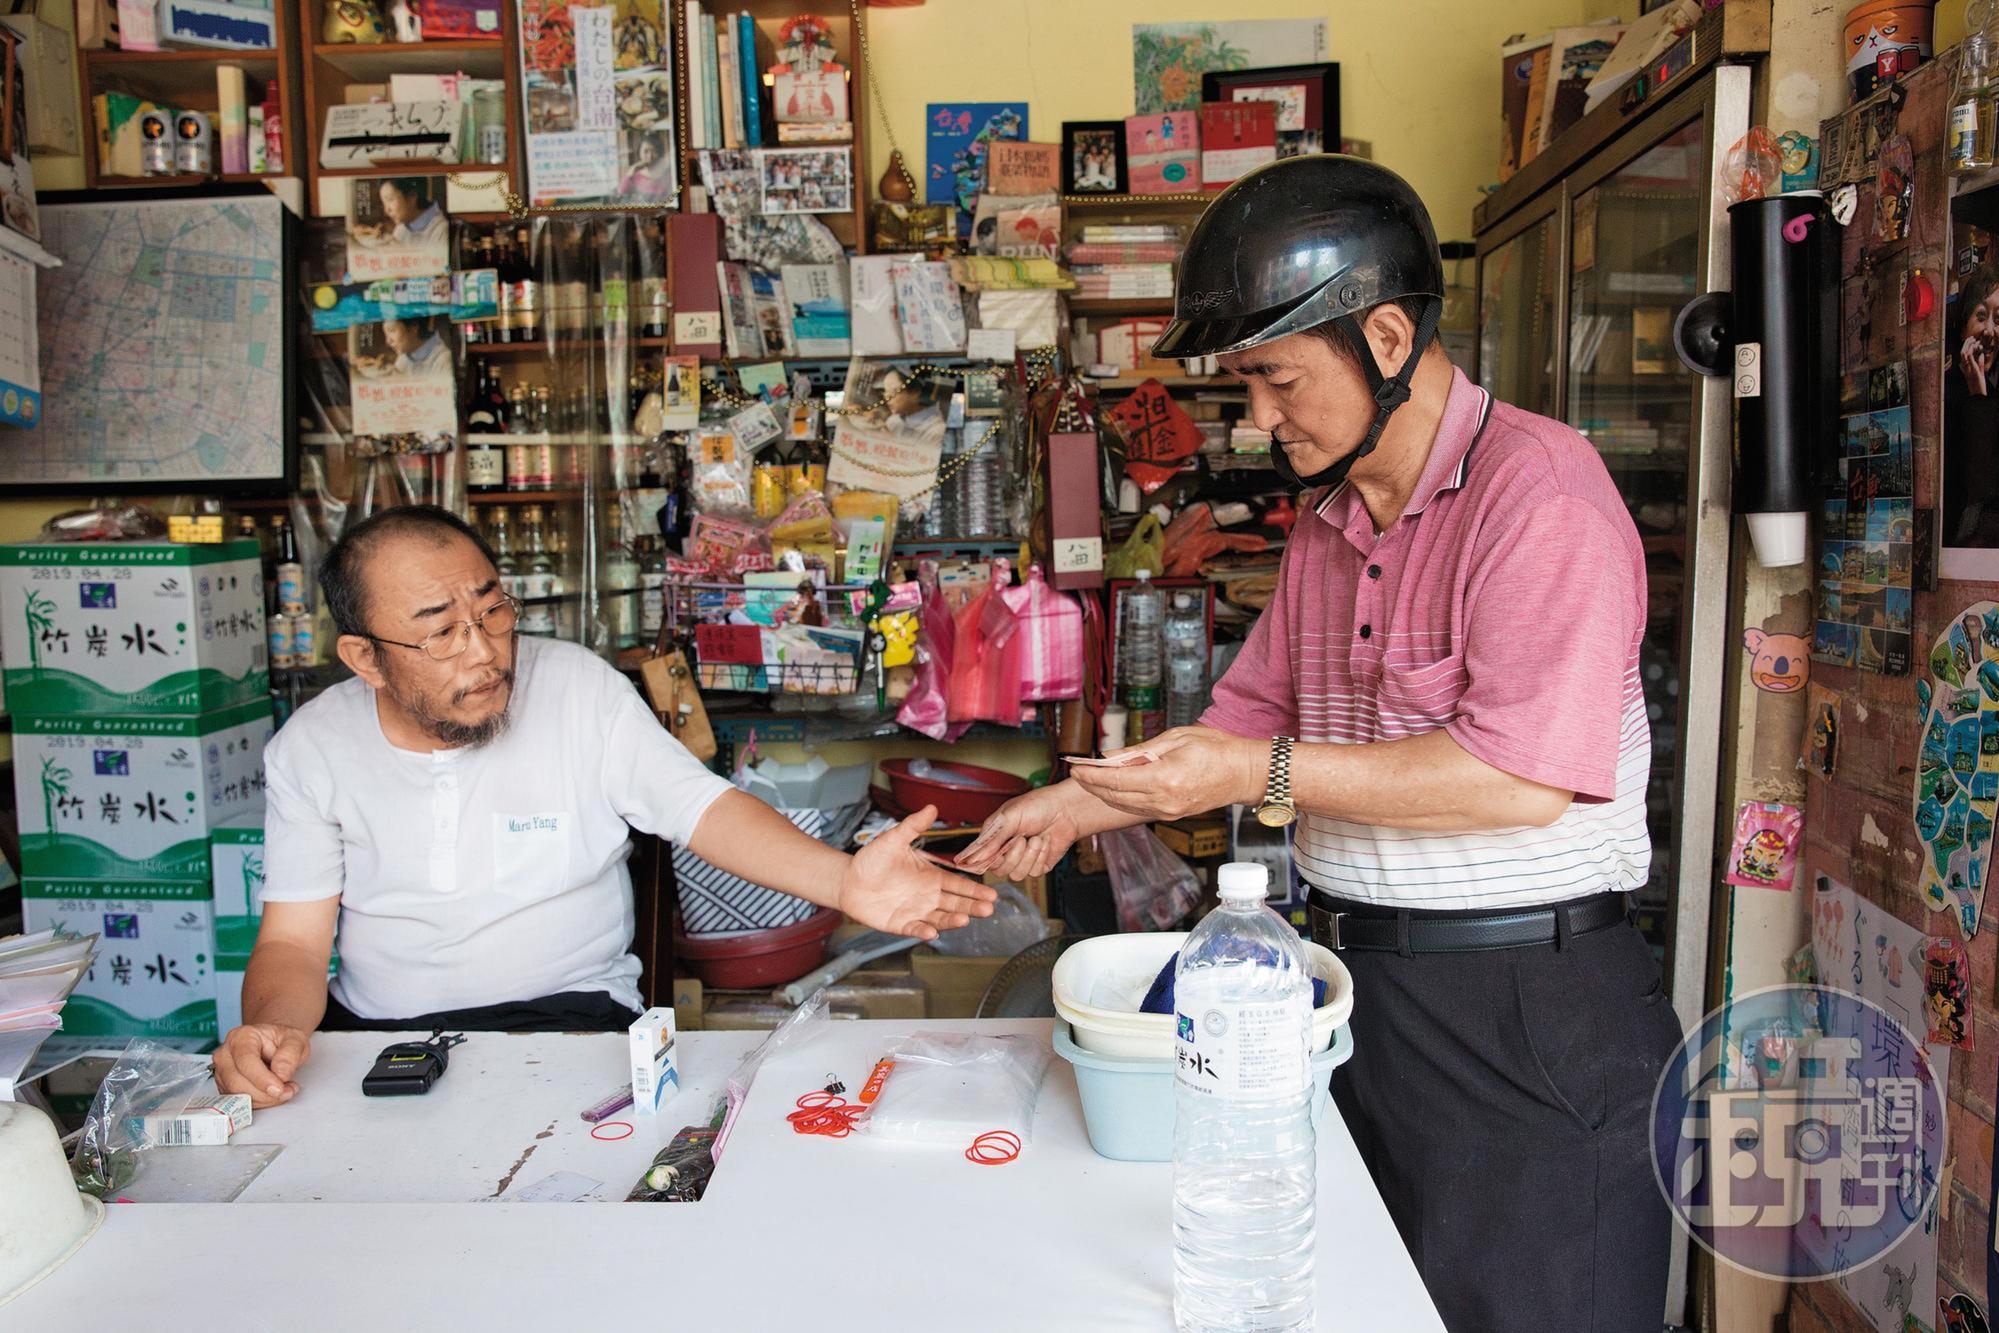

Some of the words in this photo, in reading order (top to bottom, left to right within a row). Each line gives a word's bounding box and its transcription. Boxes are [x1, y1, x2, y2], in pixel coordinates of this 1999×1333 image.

[592, 12, 614, 127] わたしの台南
[1881, 58, 1895, 73] Y
[18, 550, 69, 562] Purity
[79, 549, 176, 562] Guaranteed
[214, 609, 259, 639] 竹炭水
[41, 622, 170, 659] 竹炭水
[34, 718, 83, 731] Purity
[93, 719, 185, 731] Guaranteed
[57, 791, 181, 825] 竹炭水
[533, 816, 557, 832] Yang
[45, 884, 94, 896] Purity
[103, 884, 195, 896] Guaranteed
[87, 953, 191, 987] 炭水
[1174, 1046, 1220, 1081] 炭水
